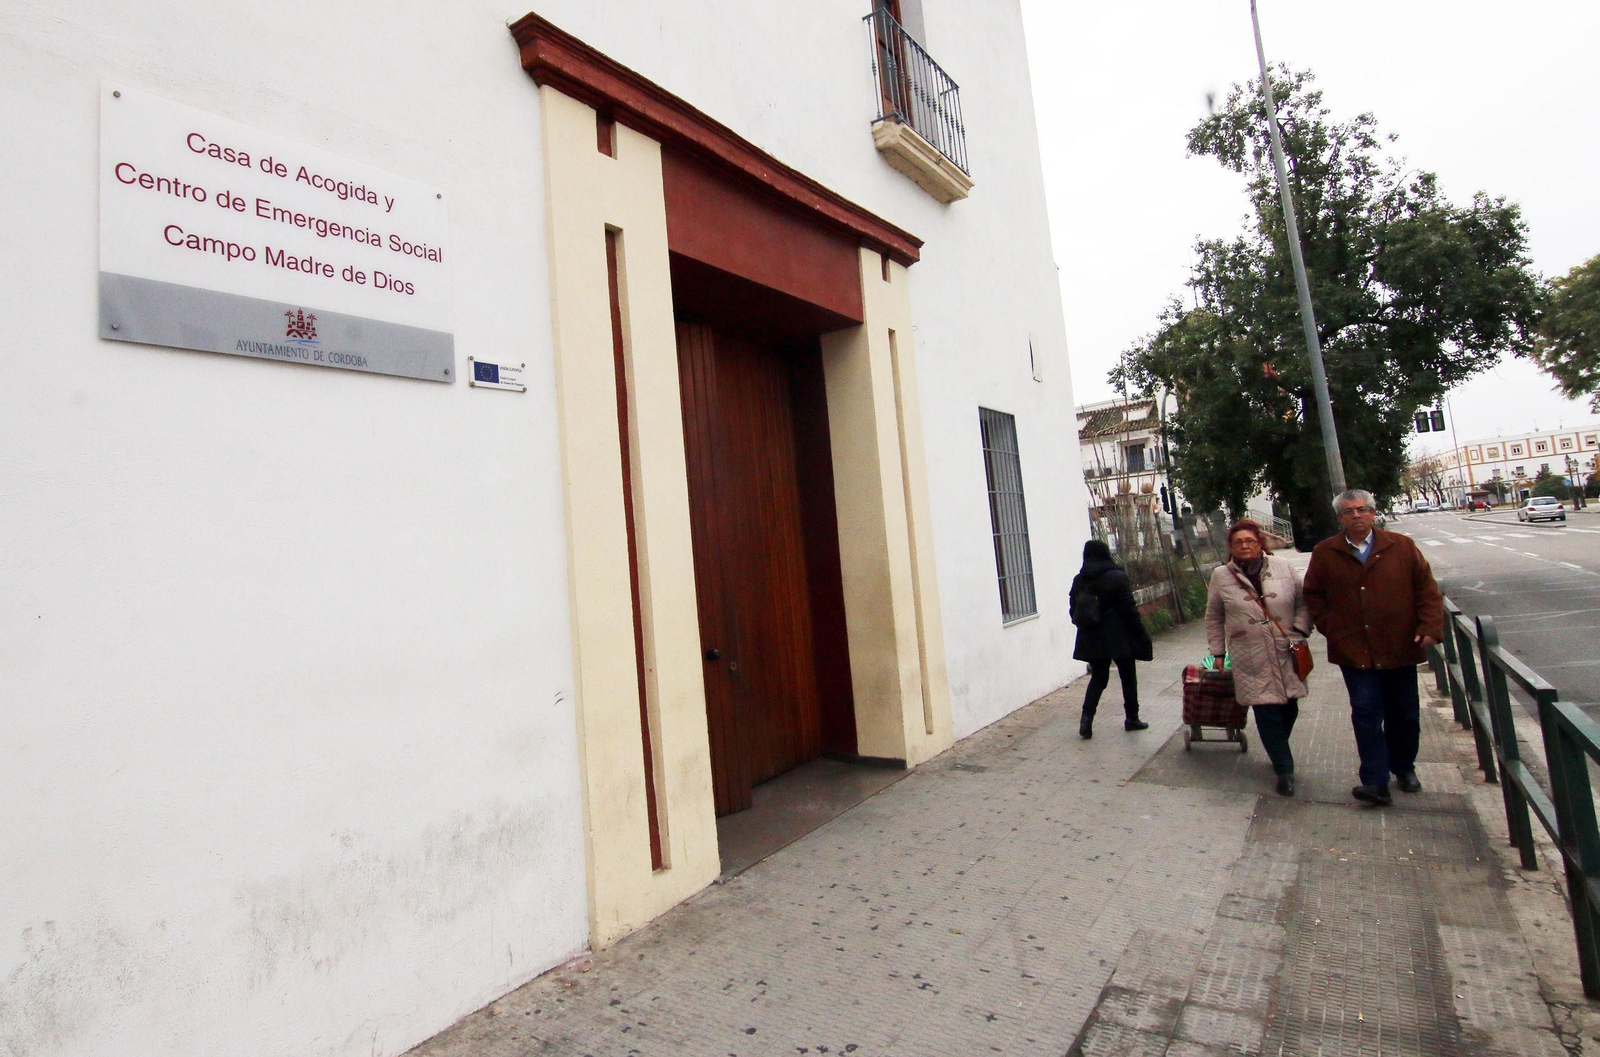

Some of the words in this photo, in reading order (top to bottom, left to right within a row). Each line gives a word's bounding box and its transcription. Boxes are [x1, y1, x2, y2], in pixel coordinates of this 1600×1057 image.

[187, 132, 252, 168] Casa
[260, 157, 288, 178] de
[296, 166, 378, 204] Acogida
[384, 195, 394, 212] y
[115, 162, 207, 202] Centro
[216, 190, 246, 212] de
[256, 198, 382, 247] Emergencia
[389, 234, 442, 263] Social
[163, 224, 256, 262] Campo
[265, 246, 334, 278] Madre
[342, 265, 366, 285] de
[374, 270, 415, 296] Dios
[236, 340, 309, 359] AYUNTAMIENTO
[314, 350, 324, 361] DE
[328, 352, 368, 367] CORDOBA
